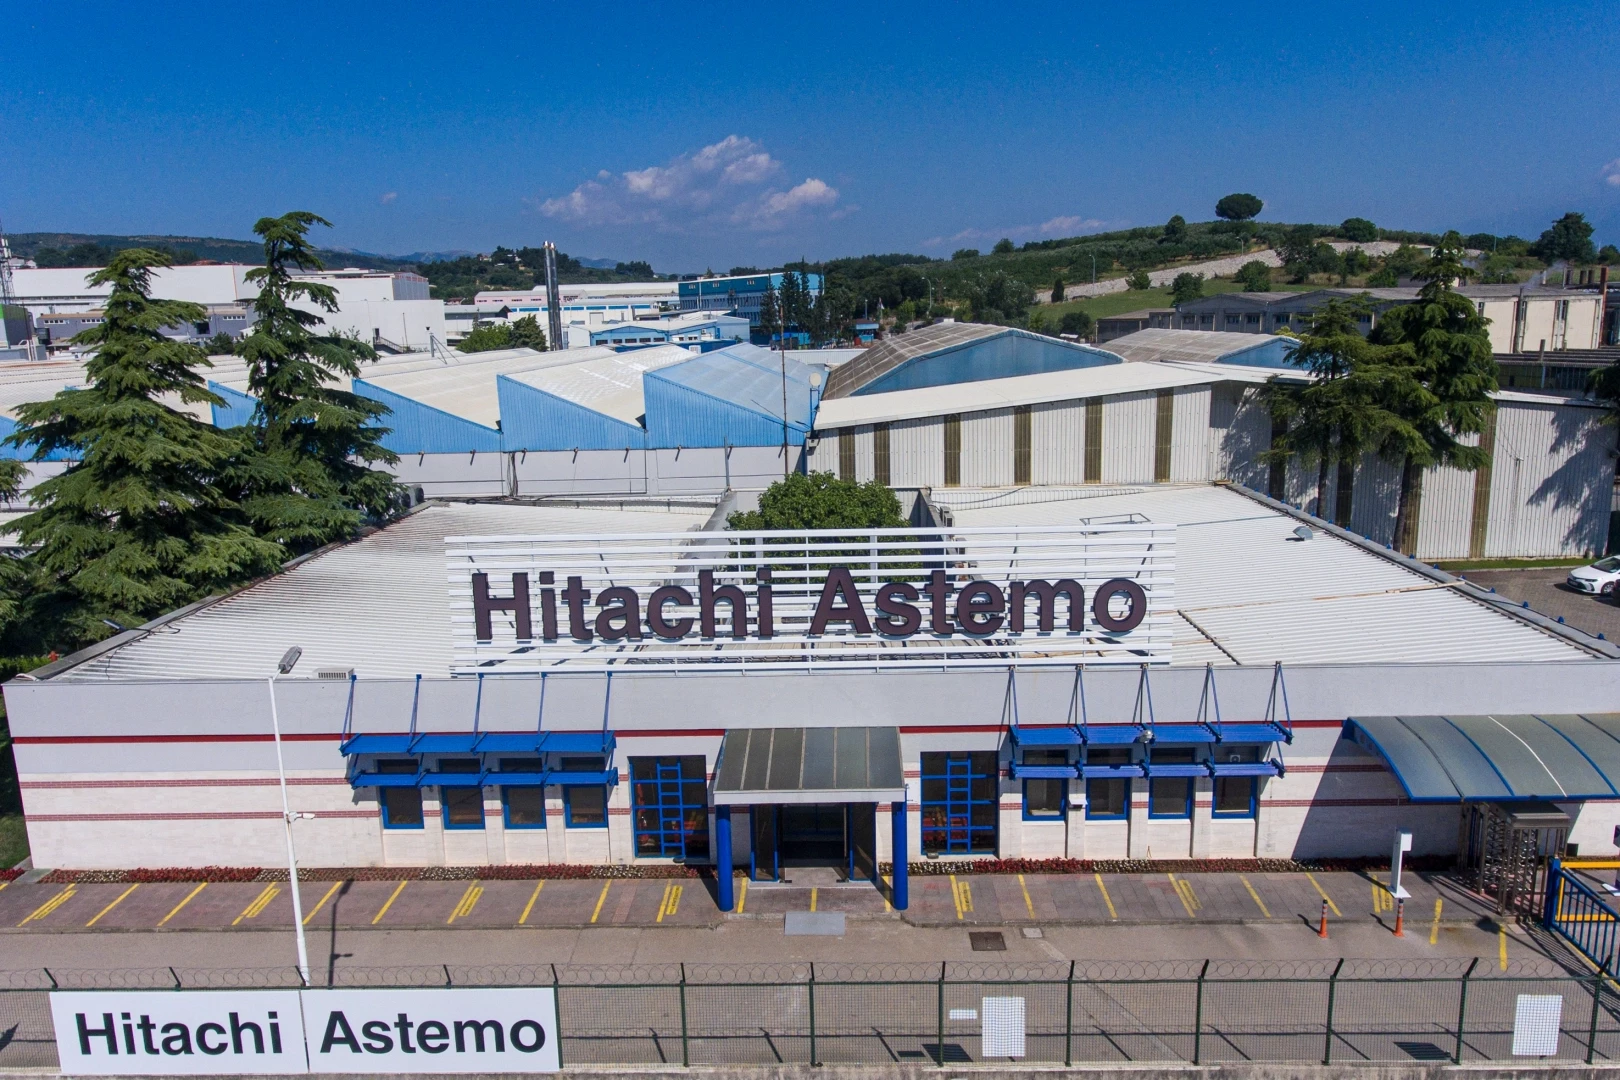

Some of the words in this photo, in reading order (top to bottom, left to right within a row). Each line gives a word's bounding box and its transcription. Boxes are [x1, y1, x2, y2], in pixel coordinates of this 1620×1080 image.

[472, 568, 773, 638] Hitachi
[810, 567, 1147, 636] Astemo
[75, 1011, 283, 1056] Hitachi
[320, 1010, 546, 1054] Astemo
